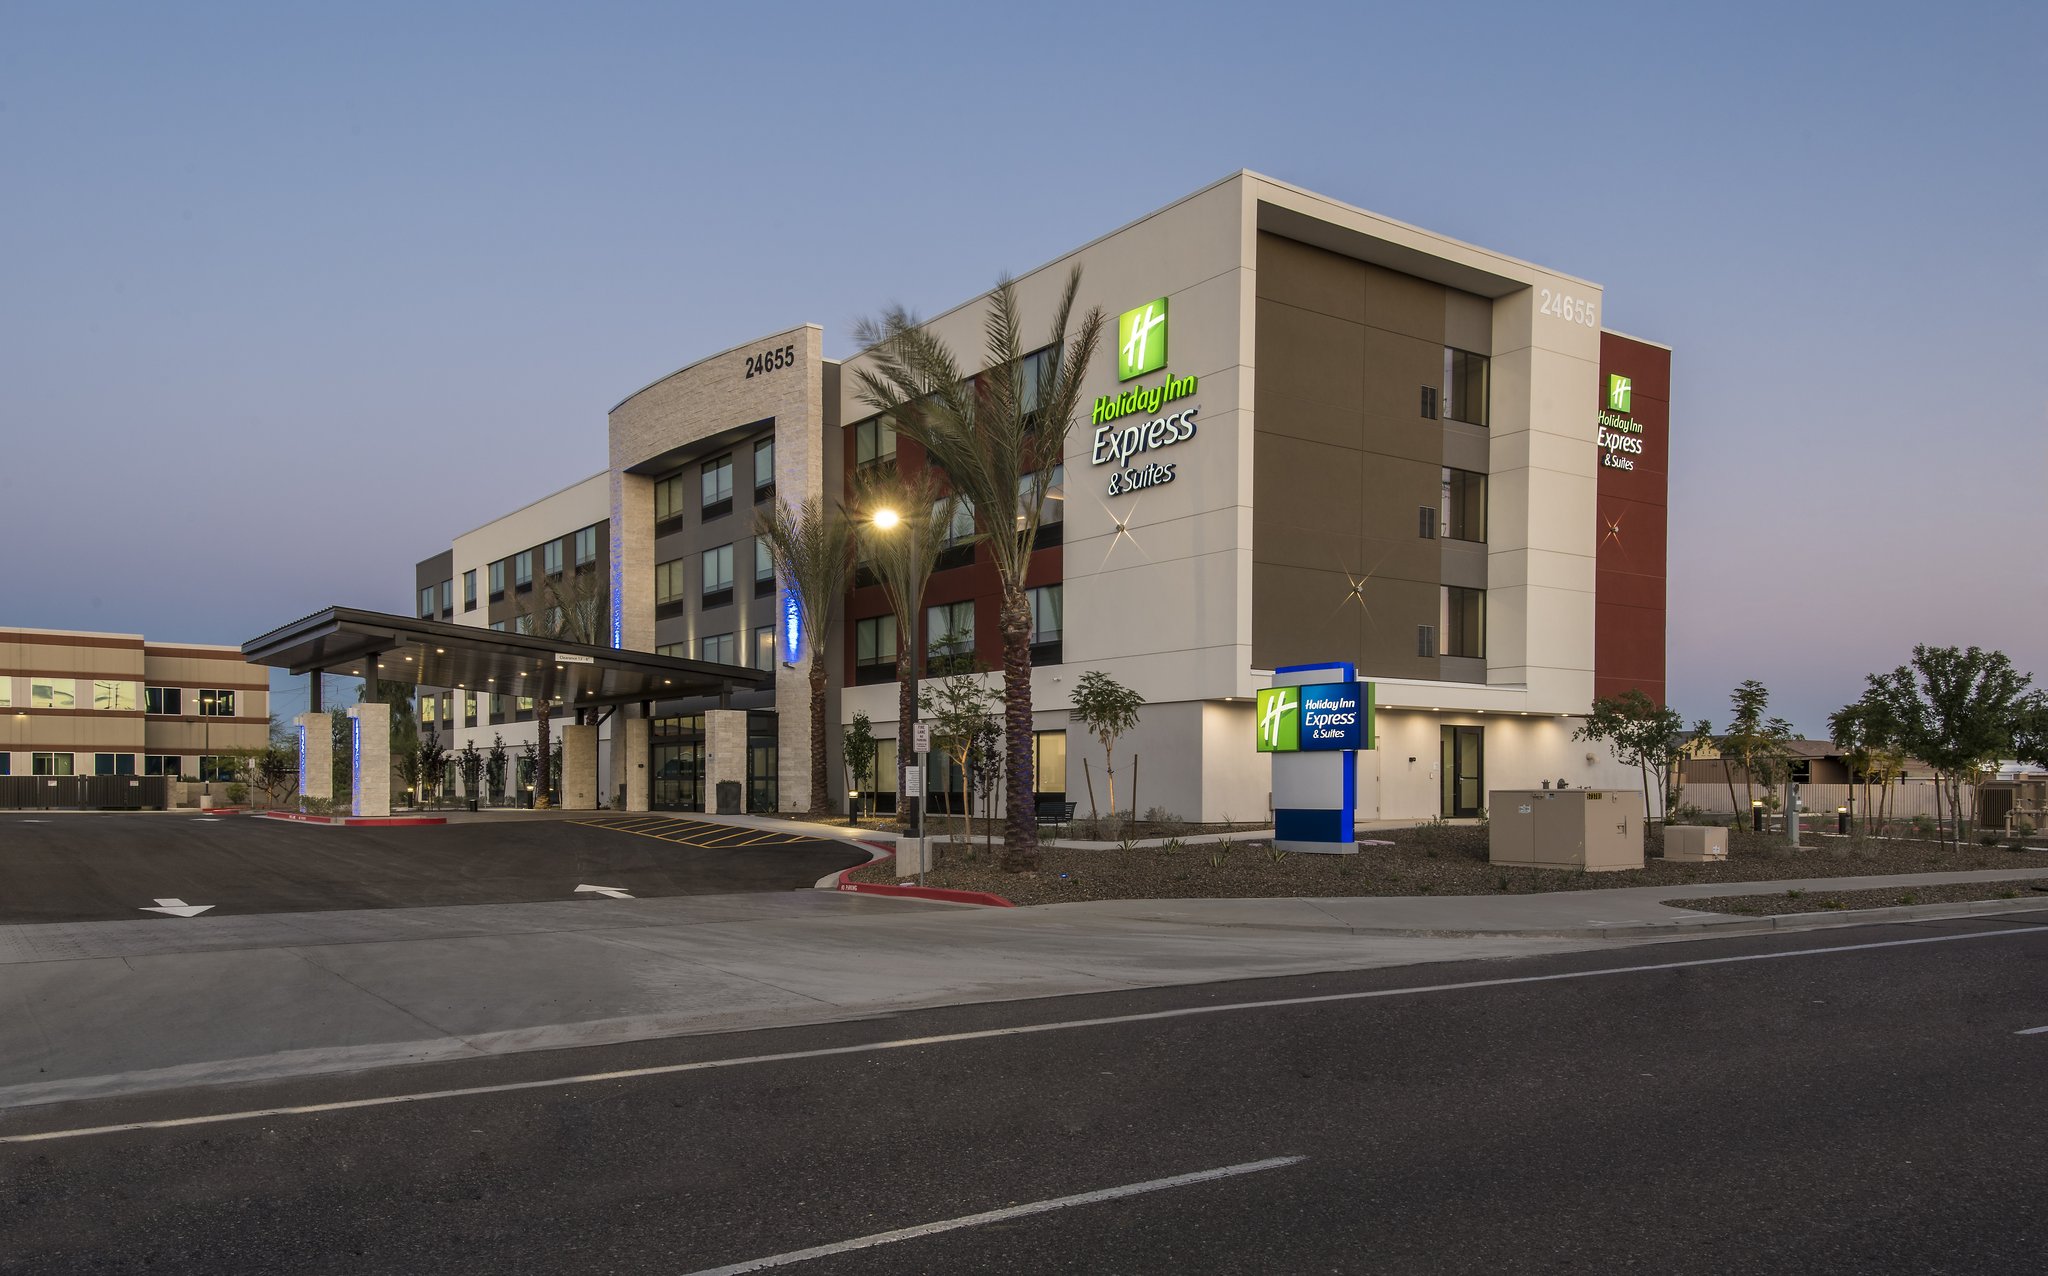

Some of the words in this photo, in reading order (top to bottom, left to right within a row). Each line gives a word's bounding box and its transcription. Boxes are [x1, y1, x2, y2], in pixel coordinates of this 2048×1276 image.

[1540, 288, 1596, 328] 24655
[745, 344, 795, 379] 24655
[1091, 384, 1163, 425] Holiday
[1164, 373, 1198, 402] Inn
[1598, 409, 1630, 433] Holiday
[1629, 417, 1643, 434] Inn
[1092, 408, 1198, 468] Express
[1597, 426, 1643, 454] Express
[1604, 453, 1611, 466] &
[1612, 454, 1634, 471] Suites
[1107, 472, 1121, 496] &
[1123, 463, 1176, 493] Suites
[1305, 698, 1339, 711] Holiday
[1339, 697, 1356, 709] Inn
[1305, 711, 1355, 729] Express
[1312, 729, 1320, 739] &
[1319, 728, 1345, 739] Suites
